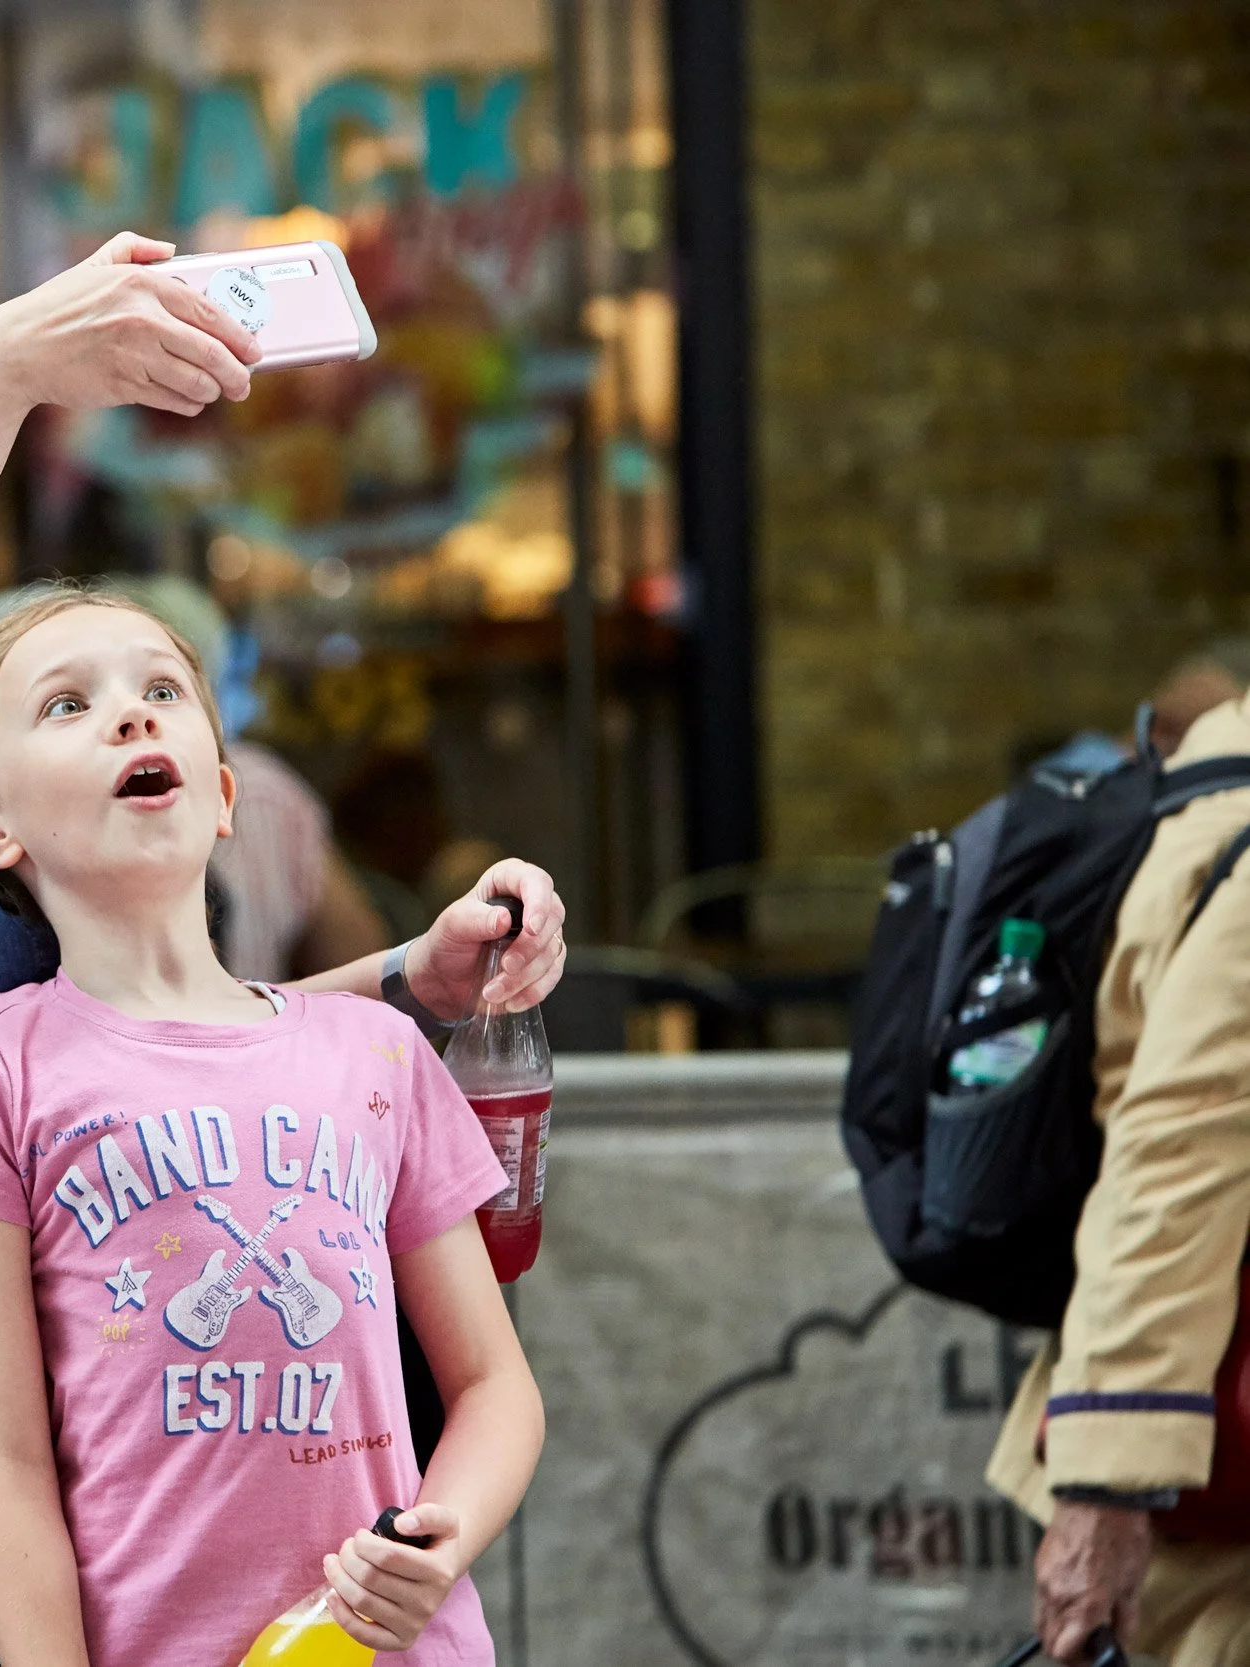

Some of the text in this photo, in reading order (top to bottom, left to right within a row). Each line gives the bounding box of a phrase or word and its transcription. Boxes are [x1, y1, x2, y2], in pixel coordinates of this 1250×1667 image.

[230, 283, 256, 308] aws
[53, 1111, 128, 1146] POWER!
[54, 1106, 241, 1250] BAND
[318, 1229, 361, 1250] LOL
[103, 1323, 130, 1342] POP
[162, 1361, 343, 1437] EST.07
[289, 1444, 337, 1464] LEAD
